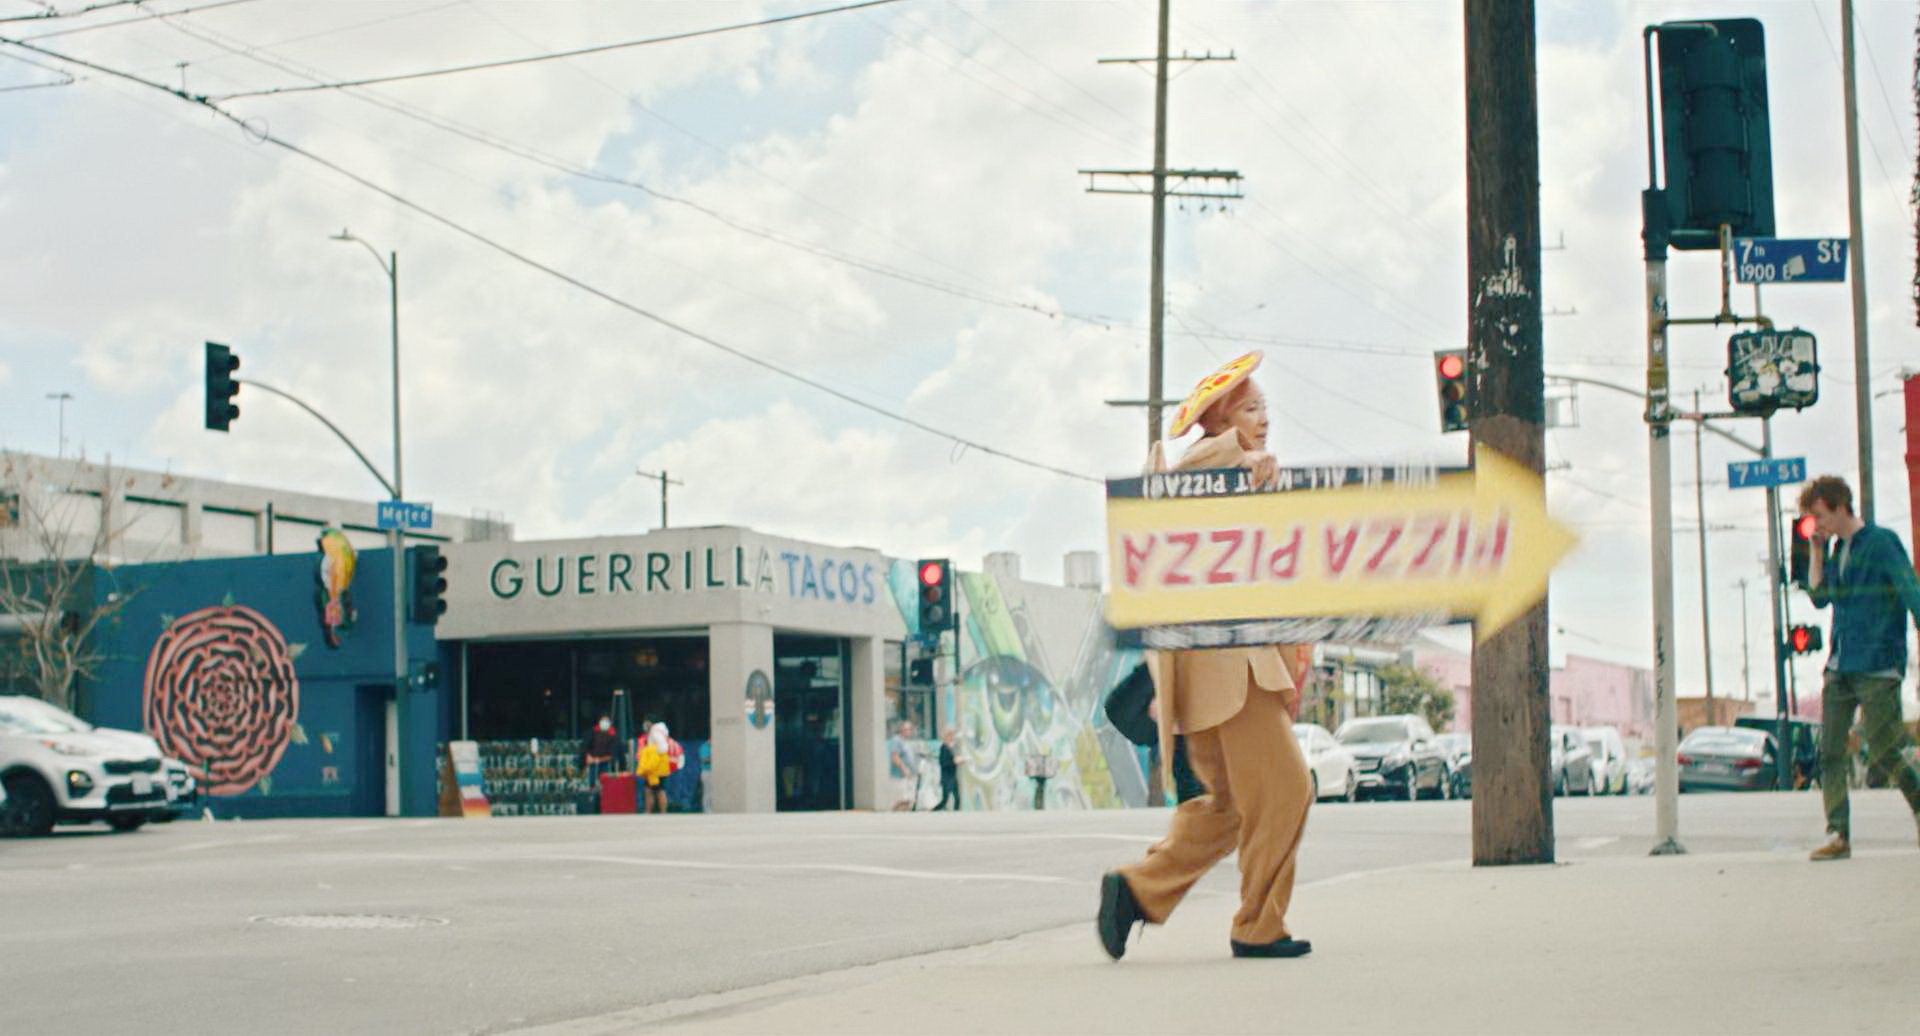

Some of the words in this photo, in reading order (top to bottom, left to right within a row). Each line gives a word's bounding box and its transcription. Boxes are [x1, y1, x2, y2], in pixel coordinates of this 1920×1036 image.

[1816, 239, 1841, 264] St
[1740, 263, 1776, 281] 1900
[1778, 462, 1800, 481] St
[382, 505, 429, 523] Mateo
[1323, 508, 1510, 576] PIZZA
[1122, 526, 1302, 586] PIZZA
[489, 545, 777, 600] GUERRILLA
[780, 551, 876, 605] TACOS
